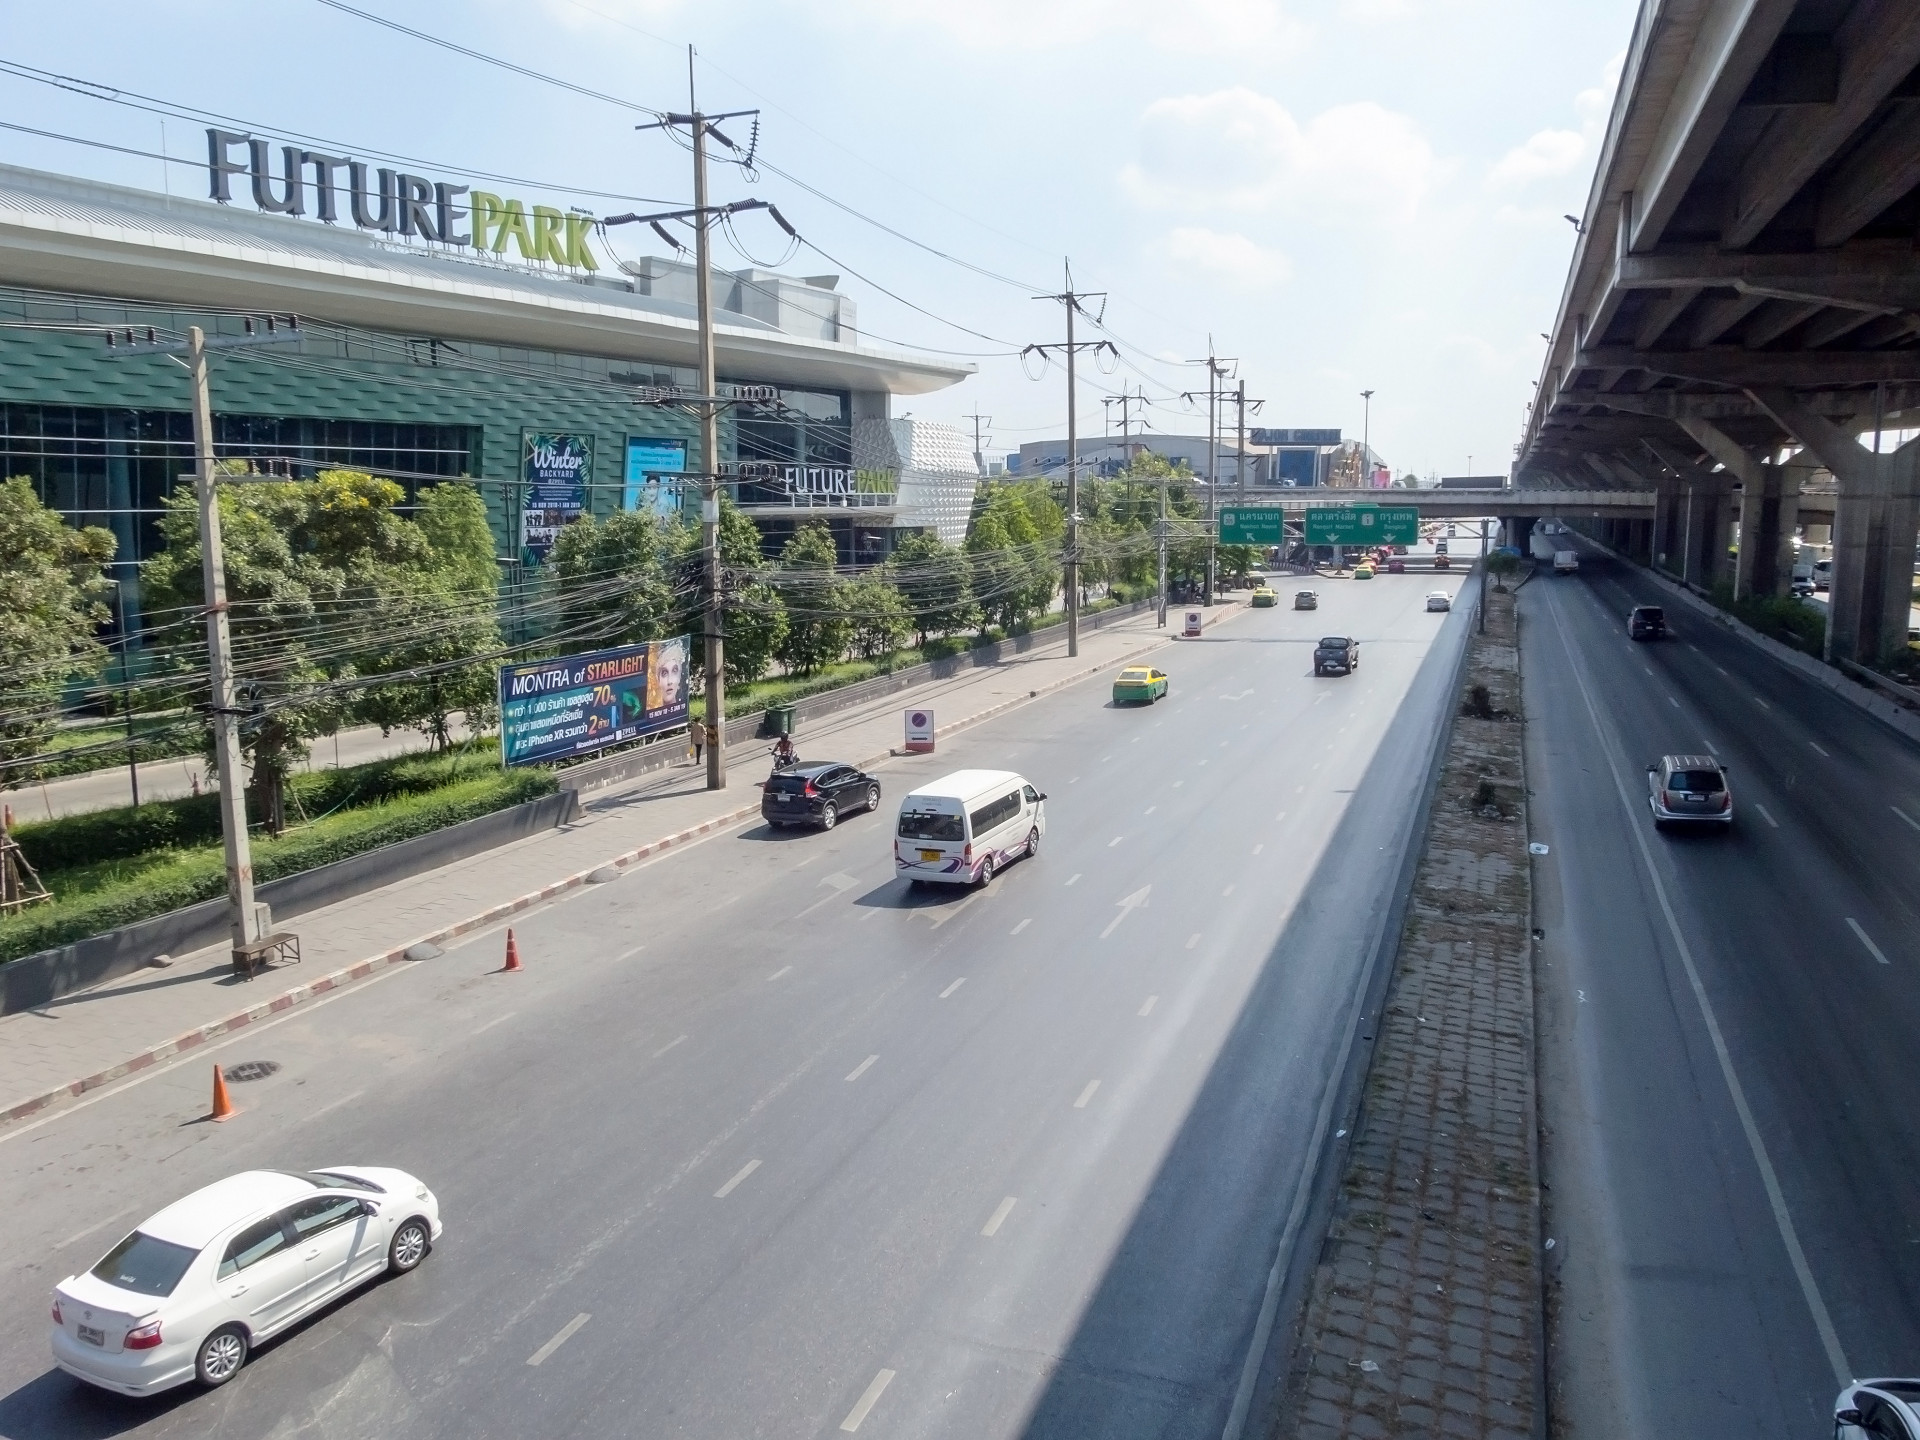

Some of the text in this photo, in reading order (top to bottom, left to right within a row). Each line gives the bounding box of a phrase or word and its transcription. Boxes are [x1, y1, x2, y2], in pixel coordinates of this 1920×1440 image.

[534, 445, 583, 469] Winter
[807, 444, 832, 456] KFC
[540, 470, 574, 478] BACKYARD
[512, 669, 570, 696] MONTRA
[574, 667, 586, 684] of
[587, 655, 645, 682] STARLIGHT
[528, 729, 553, 747] iPhone
[553, 727, 565, 741] XR
[587, 715, 598, 735] 2
